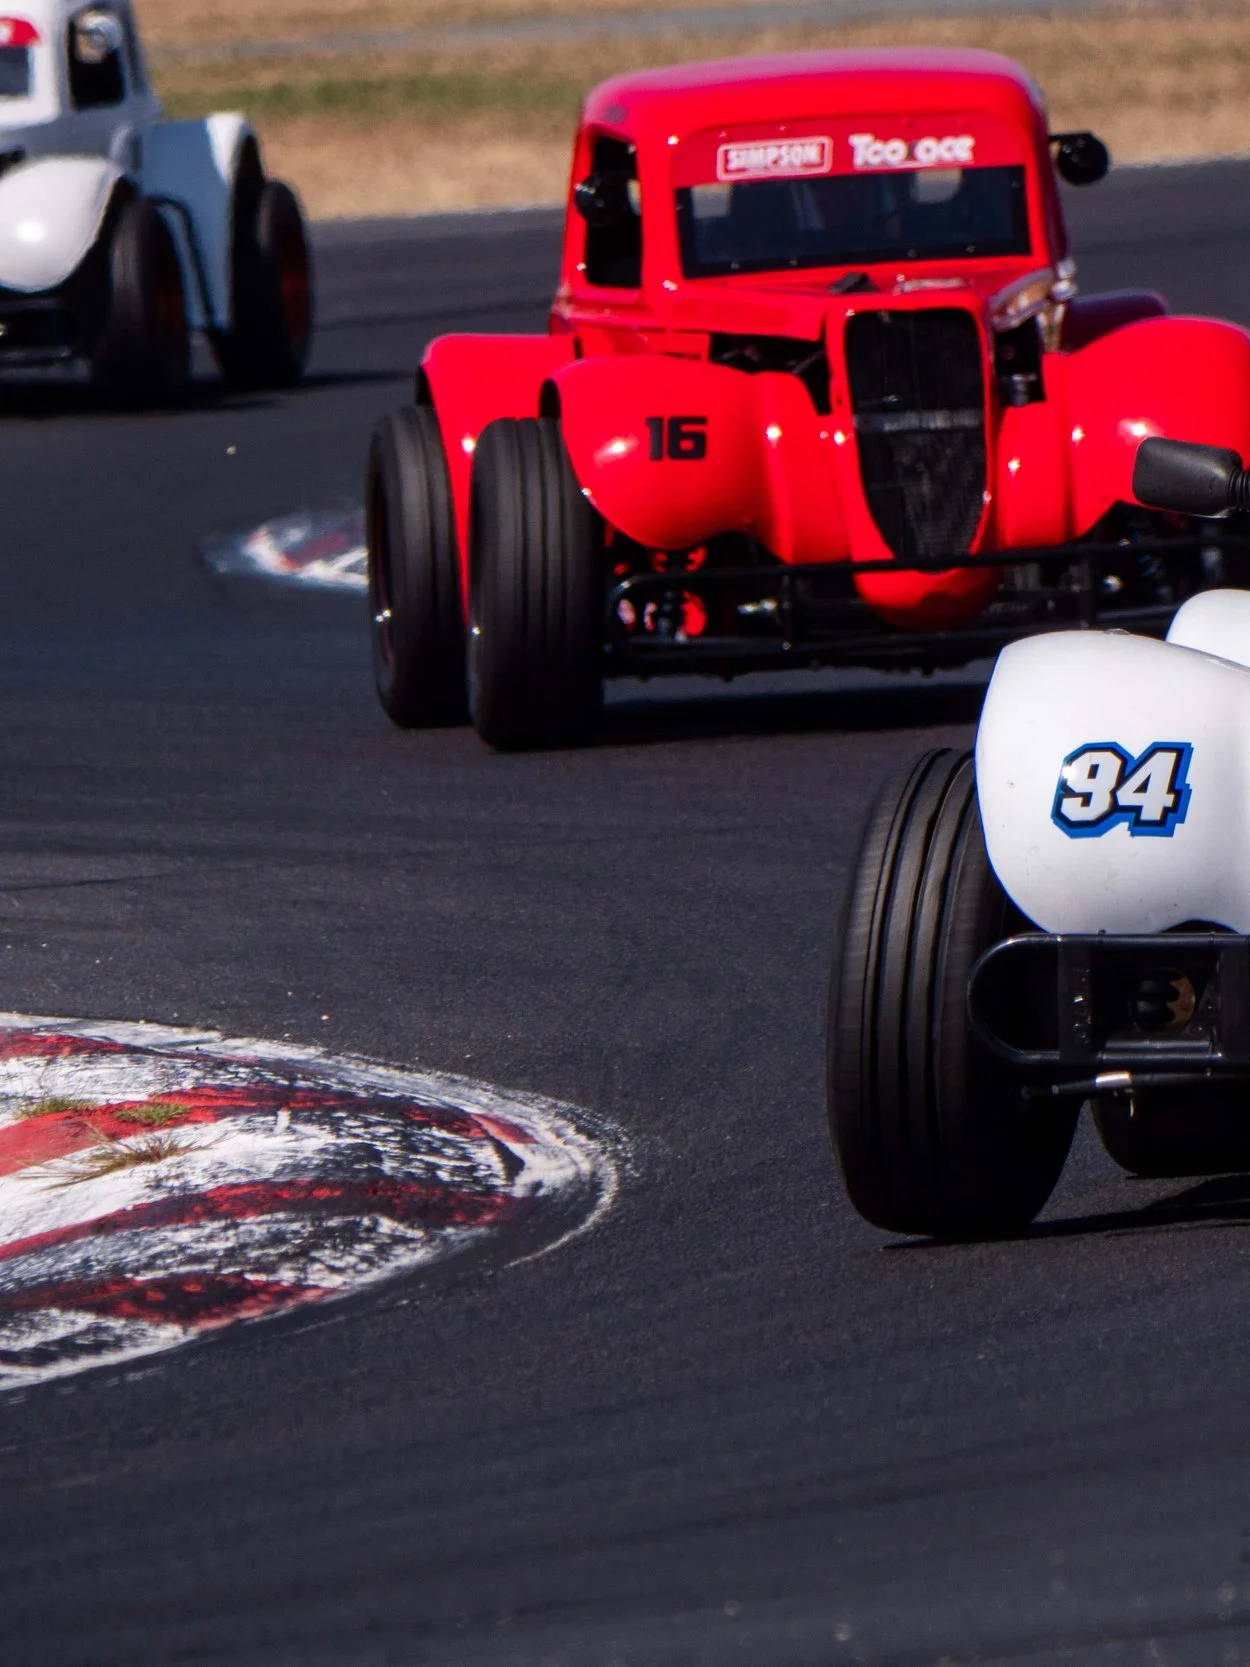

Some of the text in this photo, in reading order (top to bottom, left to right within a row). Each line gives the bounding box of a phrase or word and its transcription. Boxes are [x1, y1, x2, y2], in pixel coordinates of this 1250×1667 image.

[727, 143, 822, 170] SIMPSON
[645, 416, 707, 460] 16
[1054, 746, 1186, 830] 94
